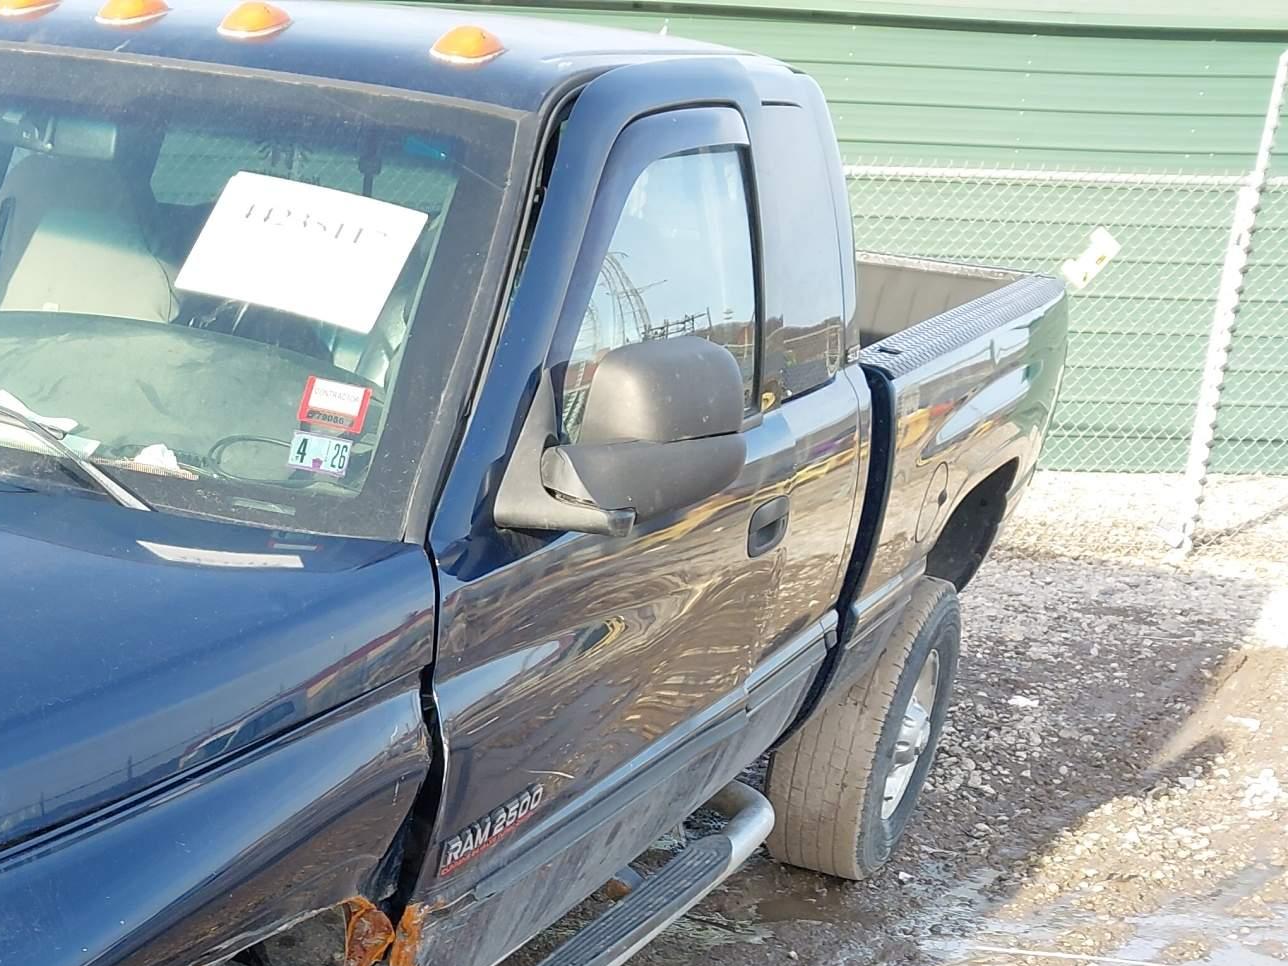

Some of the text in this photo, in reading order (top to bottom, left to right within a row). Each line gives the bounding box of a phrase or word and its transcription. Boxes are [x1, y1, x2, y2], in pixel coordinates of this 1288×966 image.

[295, 437, 349, 470] 4 26
[446, 818, 492, 865] RAM
[492, 785, 544, 836] 2500
